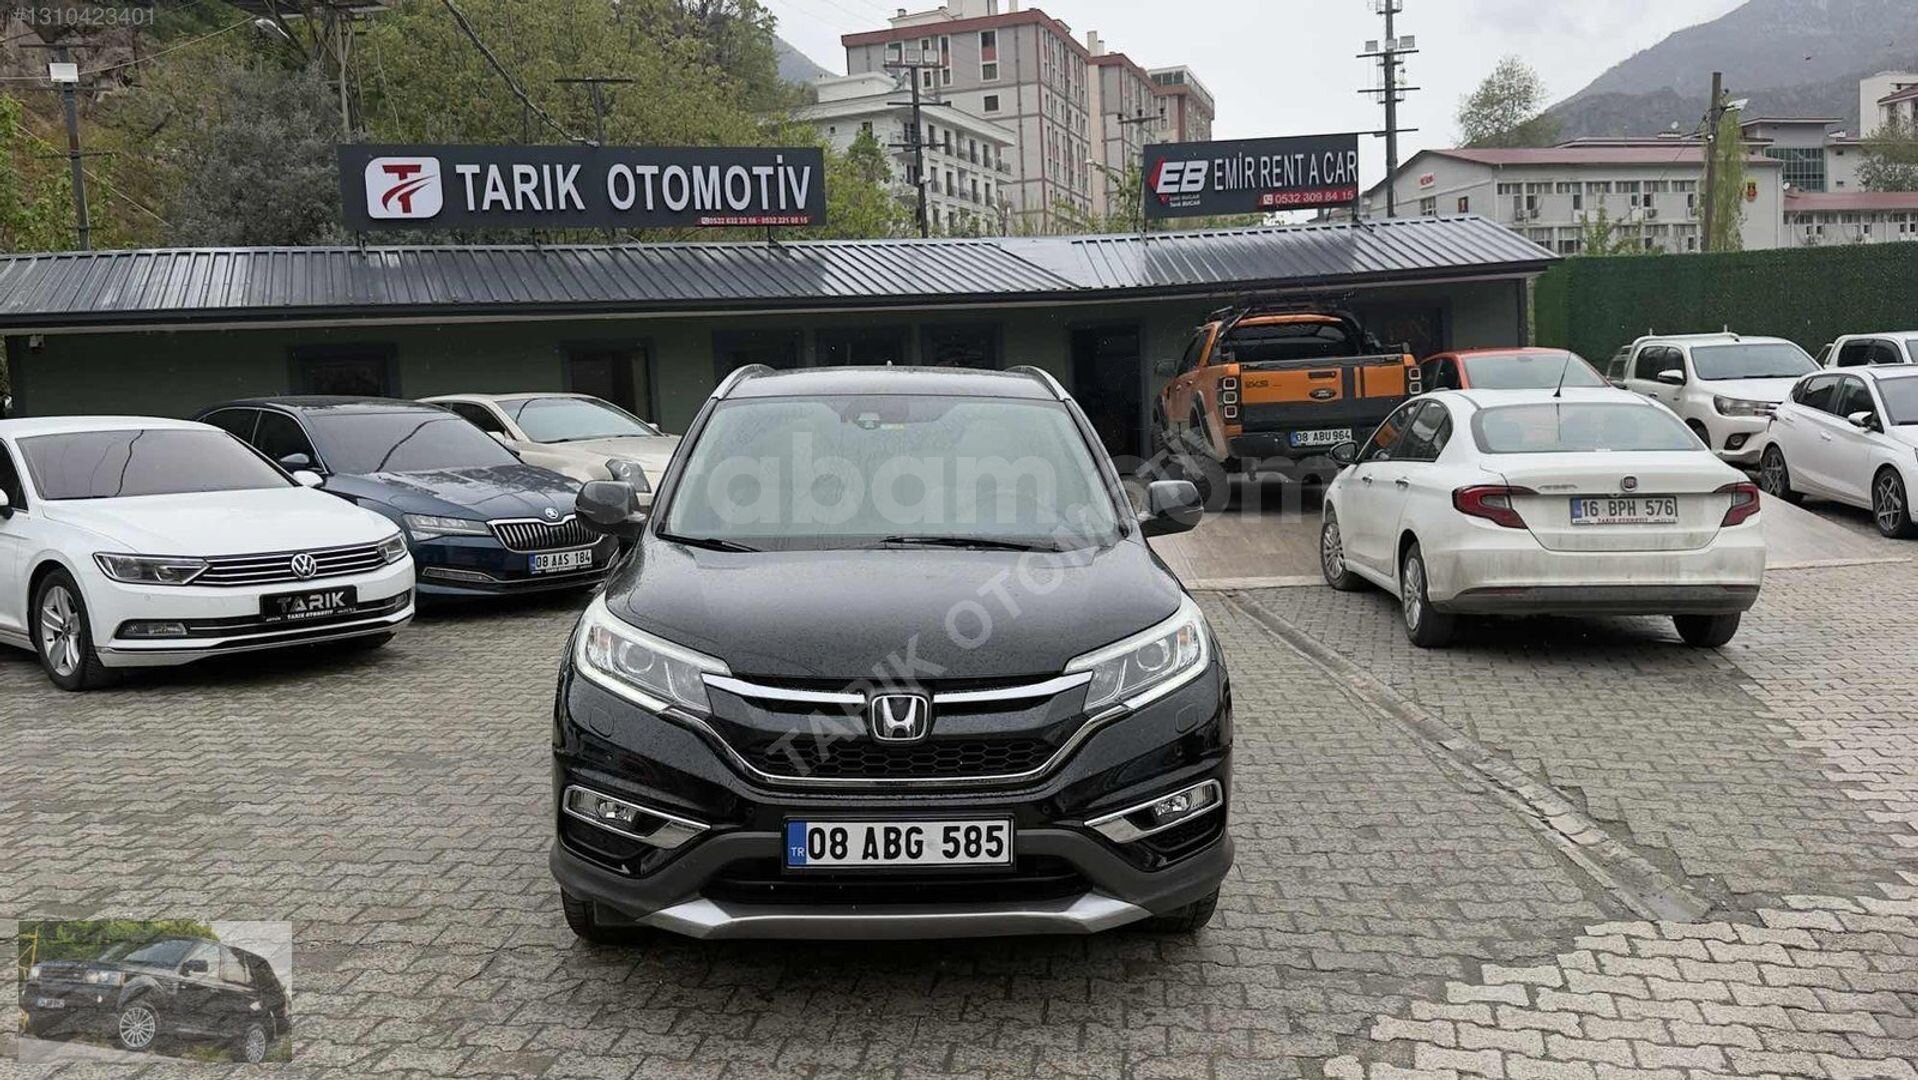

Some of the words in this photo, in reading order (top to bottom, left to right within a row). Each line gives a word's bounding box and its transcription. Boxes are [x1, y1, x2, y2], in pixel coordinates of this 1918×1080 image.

[1156, 160, 1209, 194] EB
[1214, 152, 1255, 191] EMİR
[1260, 153, 1304, 188] RENT
[1309, 156, 1320, 185] A
[1323, 151, 1357, 184] CAR
[455, 163, 586, 211] TARIK
[606, 154, 811, 211] OTOMOTİV
[1275, 192, 1300, 205] 0532
[1303, 191, 1323, 203] 309
[1325, 191, 1338, 202] 84
[1342, 189, 1354, 200] 15
[1296, 433, 1308, 442] 08
[1312, 431, 1332, 441] ABU
[1332, 430, 1349, 440] 964
[1583, 500, 1599, 516] 16
[1608, 500, 1636, 516] BPH
[1645, 500, 1674, 516] 576
[536, 556, 549, 568] 08
[551, 553, 570, 566] AAS
[575, 551, 590, 564] 184
[277, 591, 346, 613] TARIK
[790, 847, 805, 857] TR
[808, 827, 848, 860] 08
[862, 826, 924, 859] ABG
[942, 825, 1004, 858] 585
